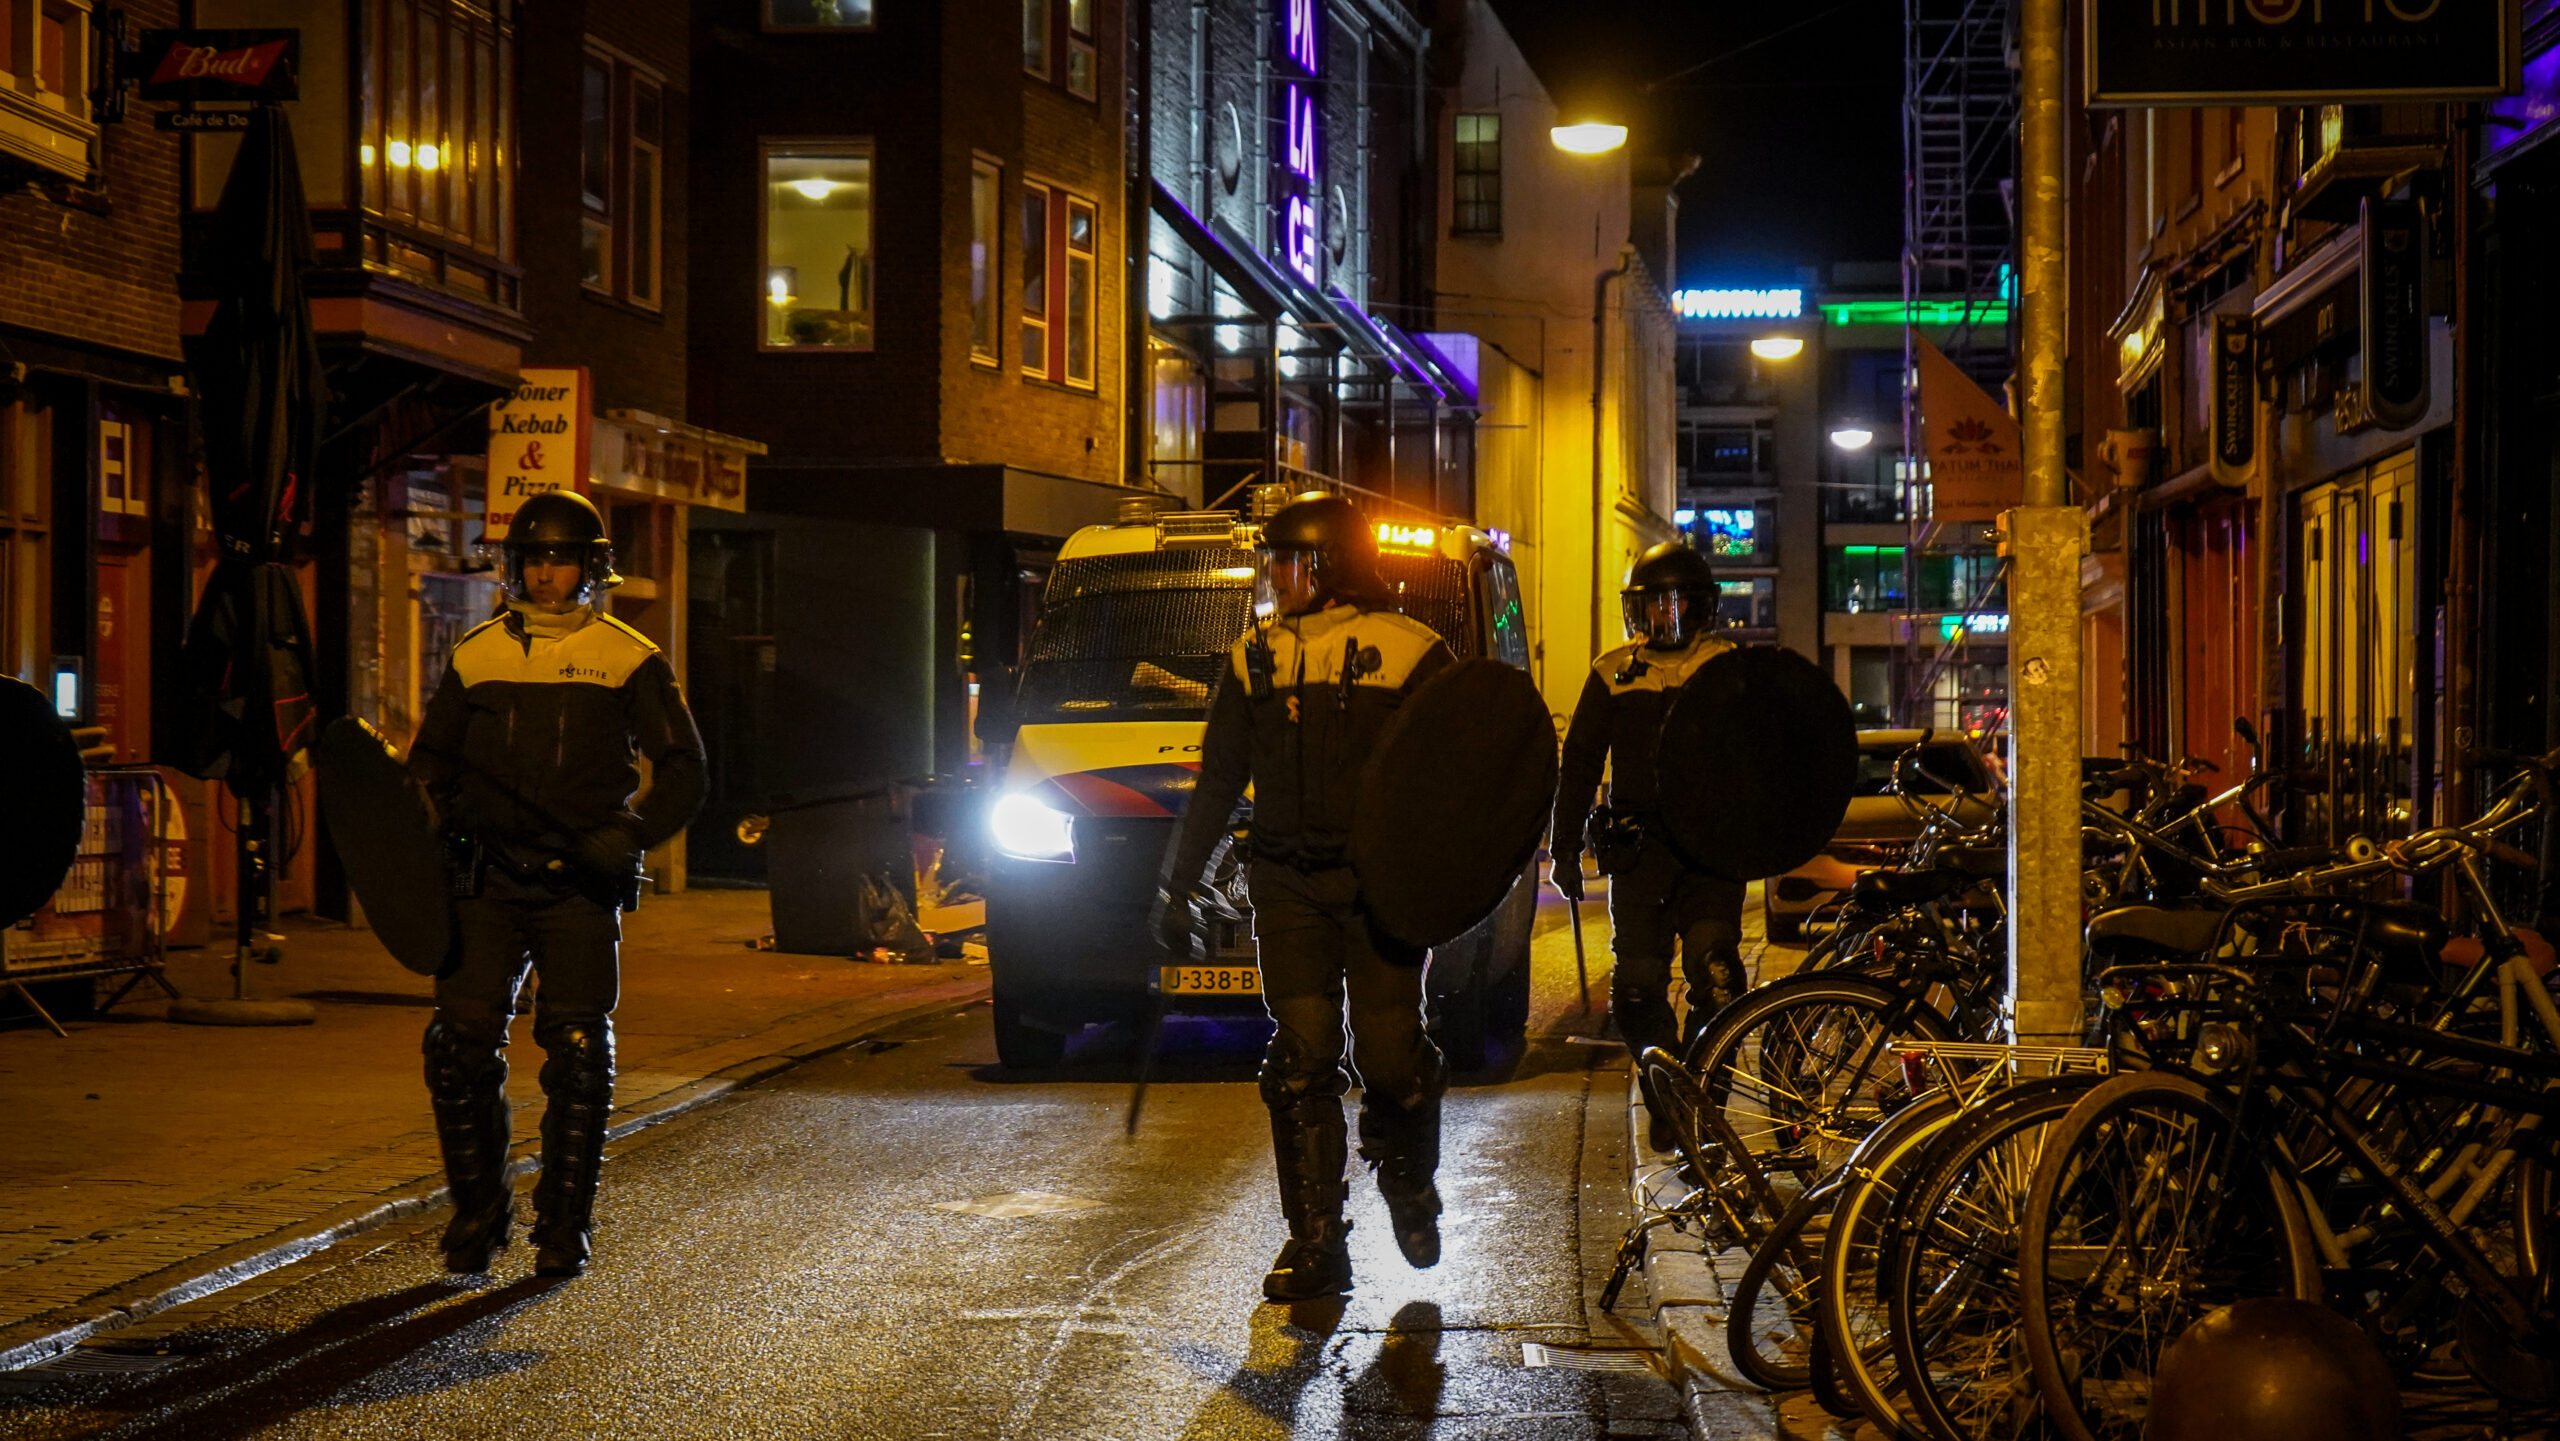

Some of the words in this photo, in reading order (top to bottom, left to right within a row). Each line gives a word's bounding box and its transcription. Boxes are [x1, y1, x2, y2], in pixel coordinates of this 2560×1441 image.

[2152, 38, 2216, 50] ASIAN
[2229, 36, 2267, 49] BAR
[2305, 32, 2441, 48] RESTAURANT
[174, 46, 254, 77] Bud
[171, 112, 203, 127] Café
[206, 112, 225, 127] de
[501, 414, 568, 434] Kebab
[518, 440, 545, 471] &
[559, 666, 608, 680] POLITIE
